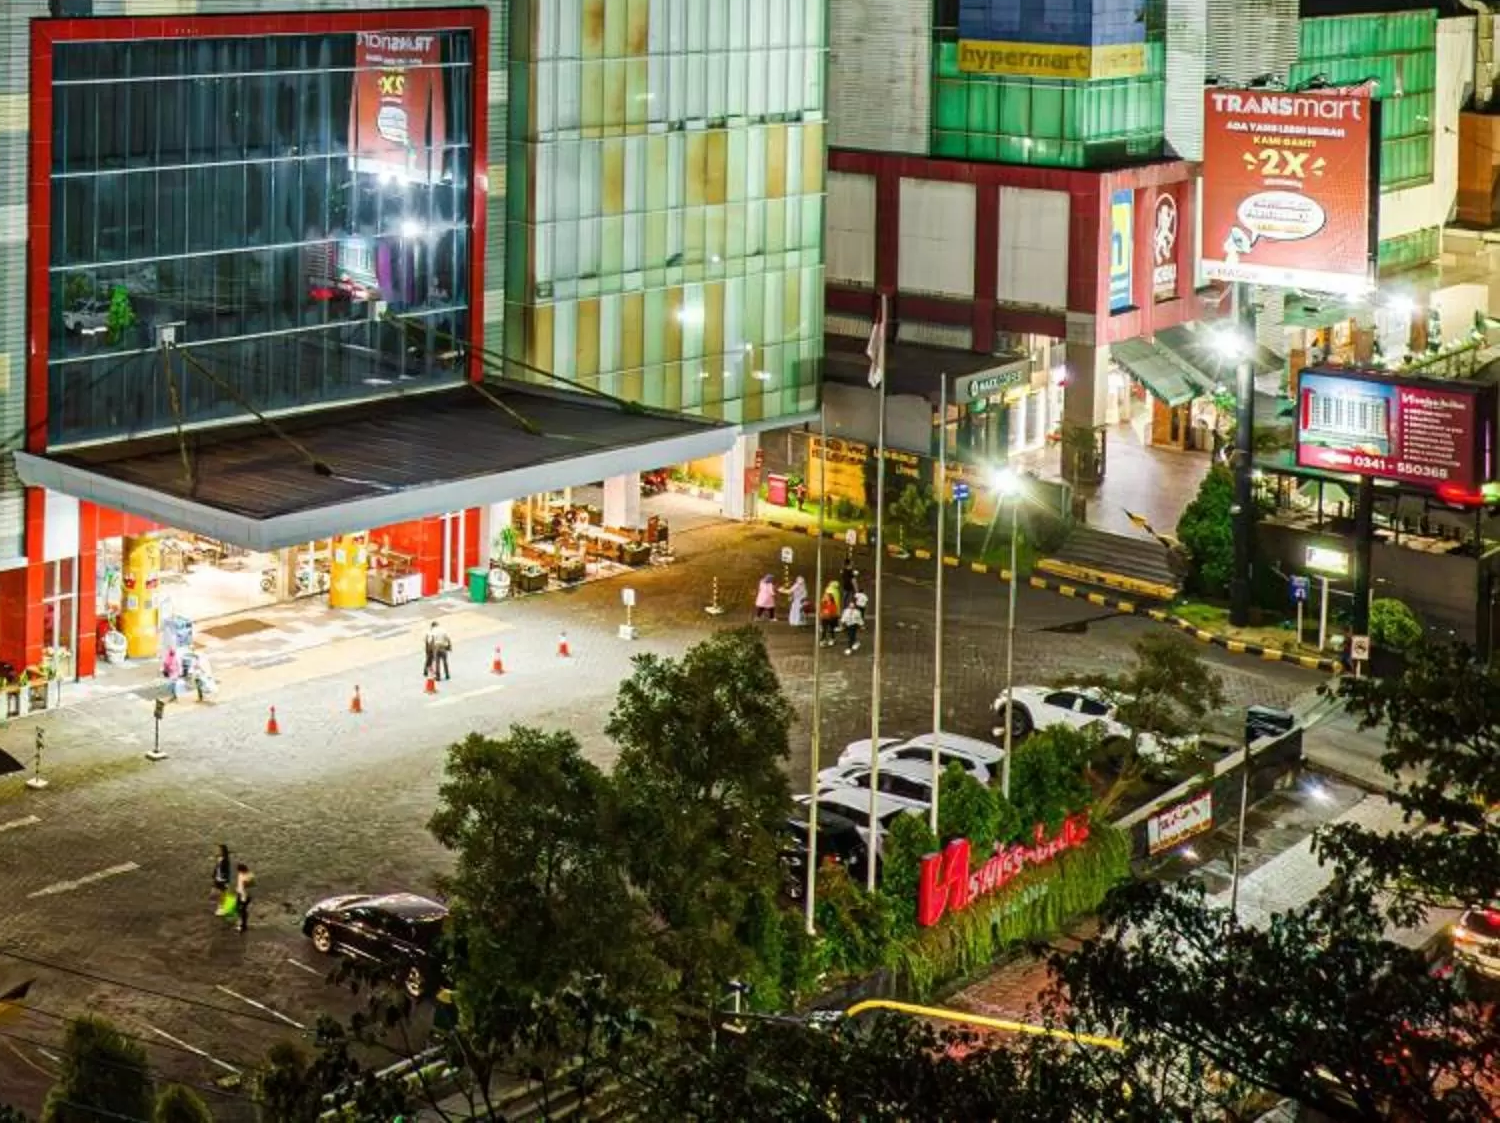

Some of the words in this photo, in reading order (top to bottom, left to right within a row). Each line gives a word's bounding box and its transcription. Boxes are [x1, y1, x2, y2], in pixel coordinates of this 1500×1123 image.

[961, 42, 1089, 71] hypermart
[1211, 93, 1362, 121] TRANSmart
[1258, 148, 1310, 178] 2X
[1353, 455, 1386, 470] 0341
